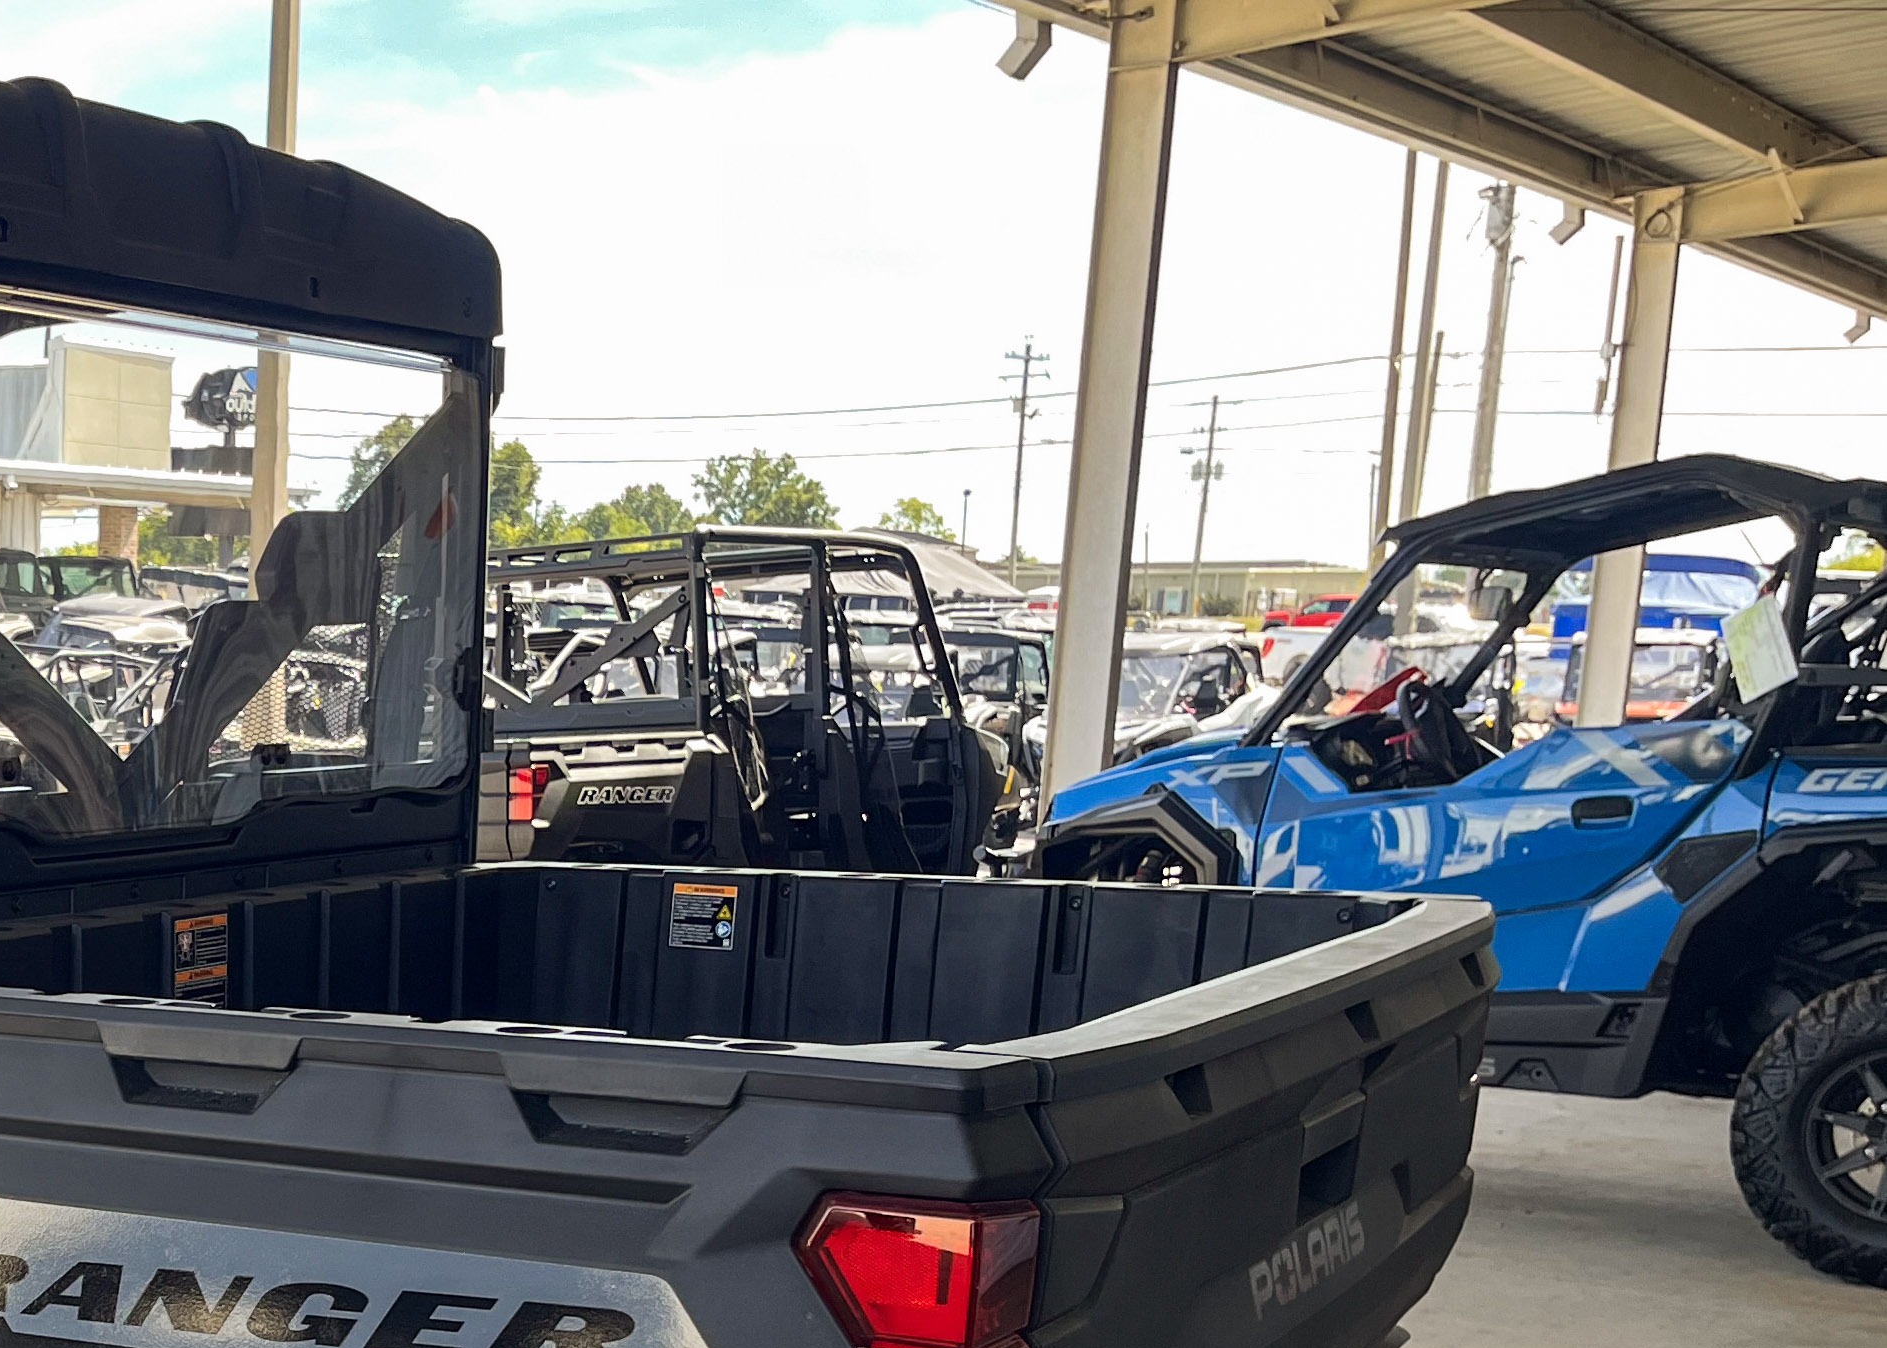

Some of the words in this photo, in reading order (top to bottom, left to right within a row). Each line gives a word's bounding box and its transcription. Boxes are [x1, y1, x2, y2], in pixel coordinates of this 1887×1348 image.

[1164, 761, 1271, 788] XP
[576, 786, 676, 805] RANGER
[1248, 1201, 1365, 1321] POLARIS
